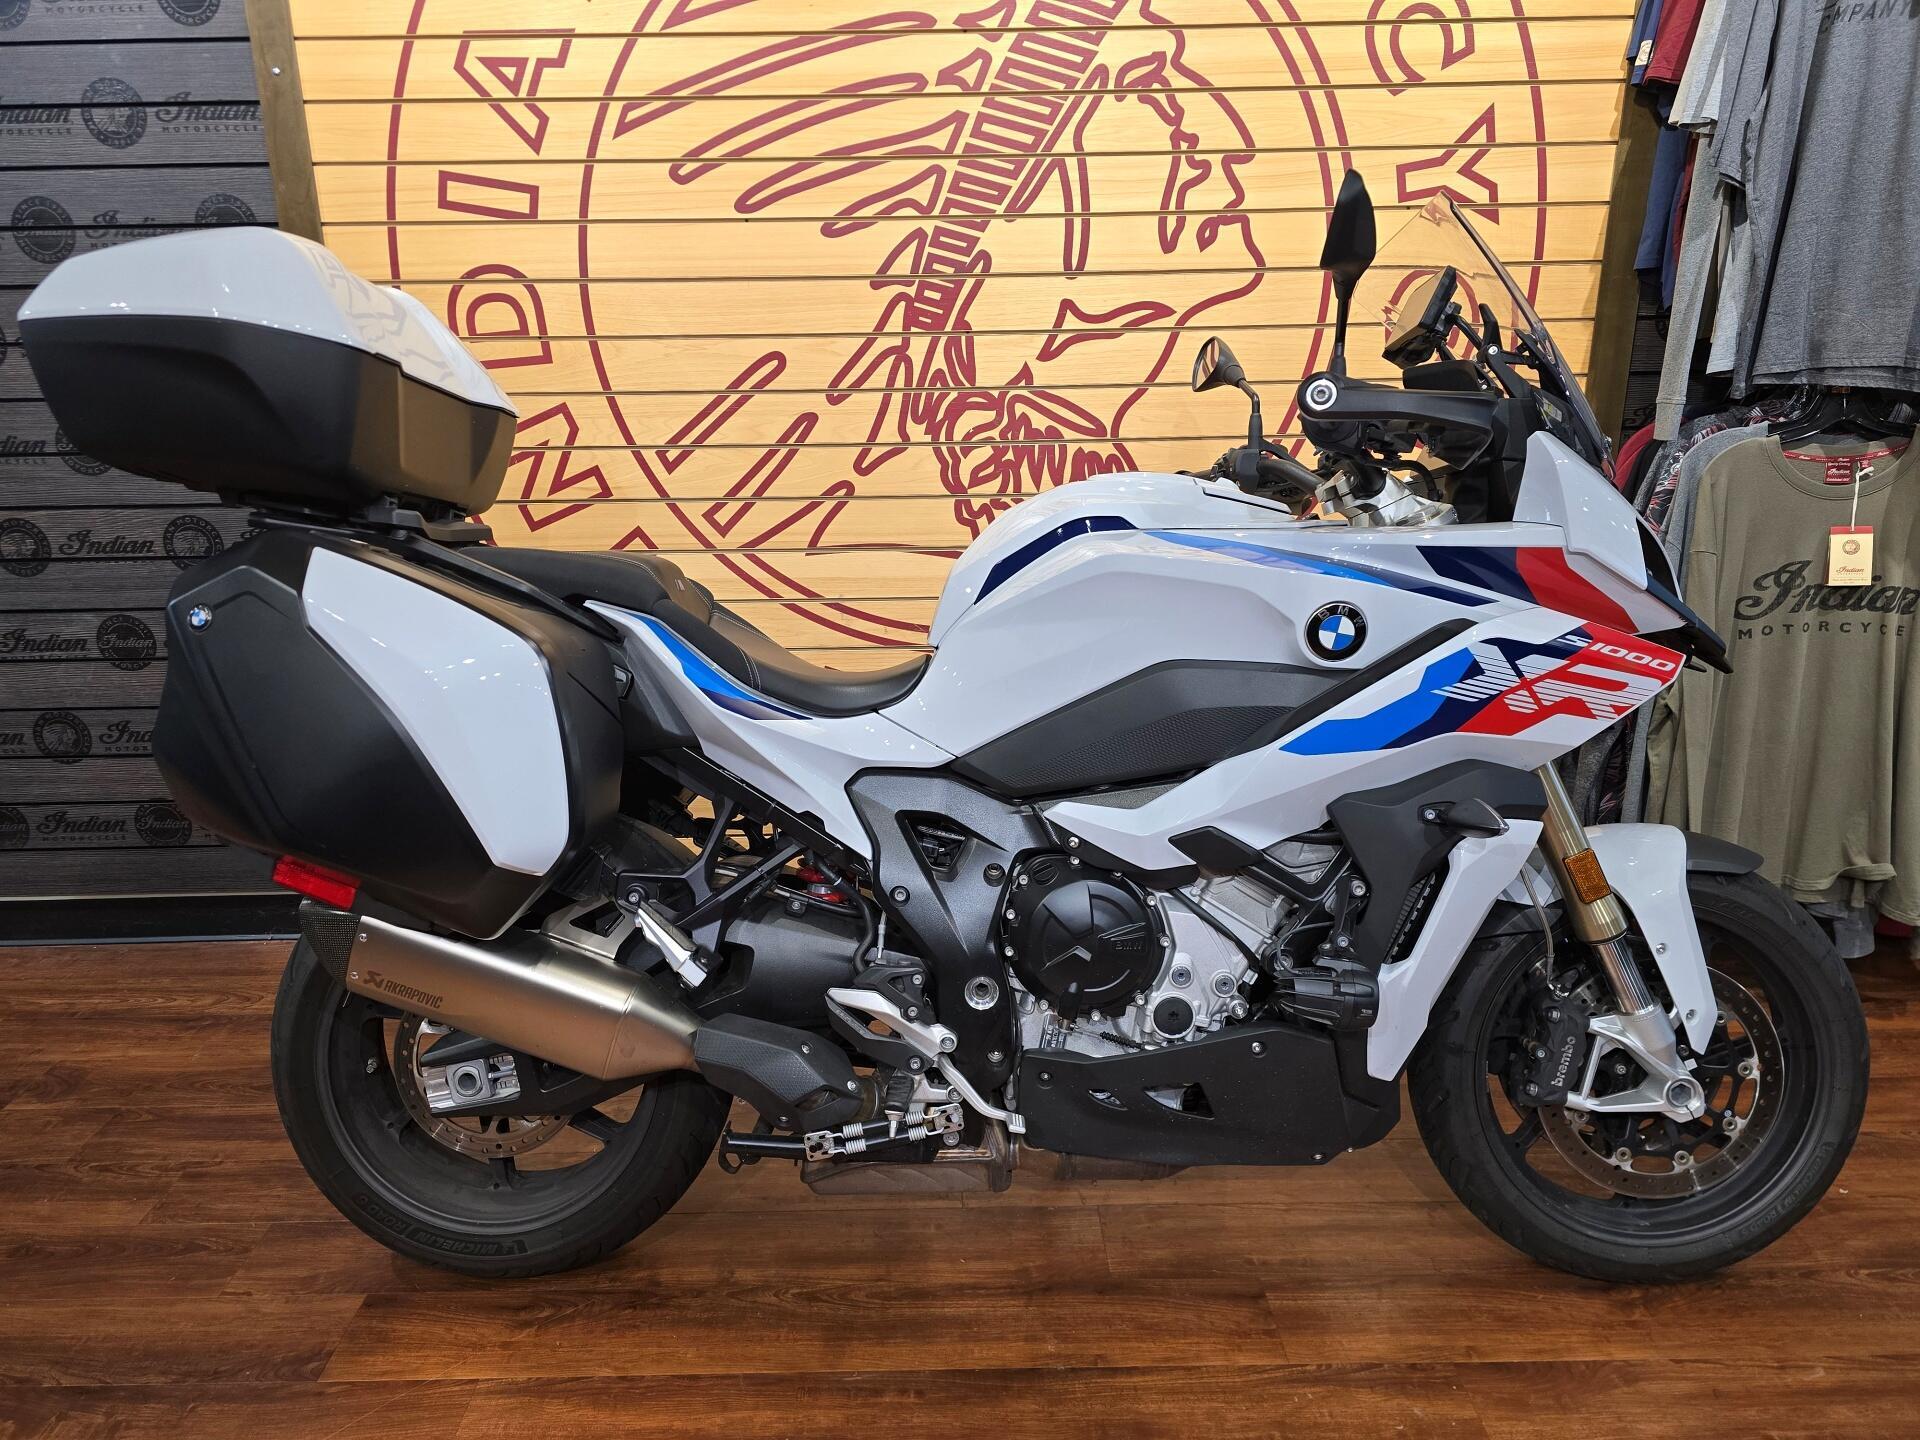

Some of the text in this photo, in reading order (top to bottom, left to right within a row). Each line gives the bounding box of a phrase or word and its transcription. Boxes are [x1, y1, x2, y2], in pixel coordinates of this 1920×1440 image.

[0, 435, 47, 454] dian
[59, 529, 155, 555] Indian
[1318, 605, 1365, 628] BMW
[1738, 621, 1905, 640] MOTORCYCE
[1588, 642, 1677, 672] 1000
[35, 810, 128, 834] Indian
[383, 979, 444, 1009] AKRAPOVIC
[1550, 1036, 1577, 1088] brembo
